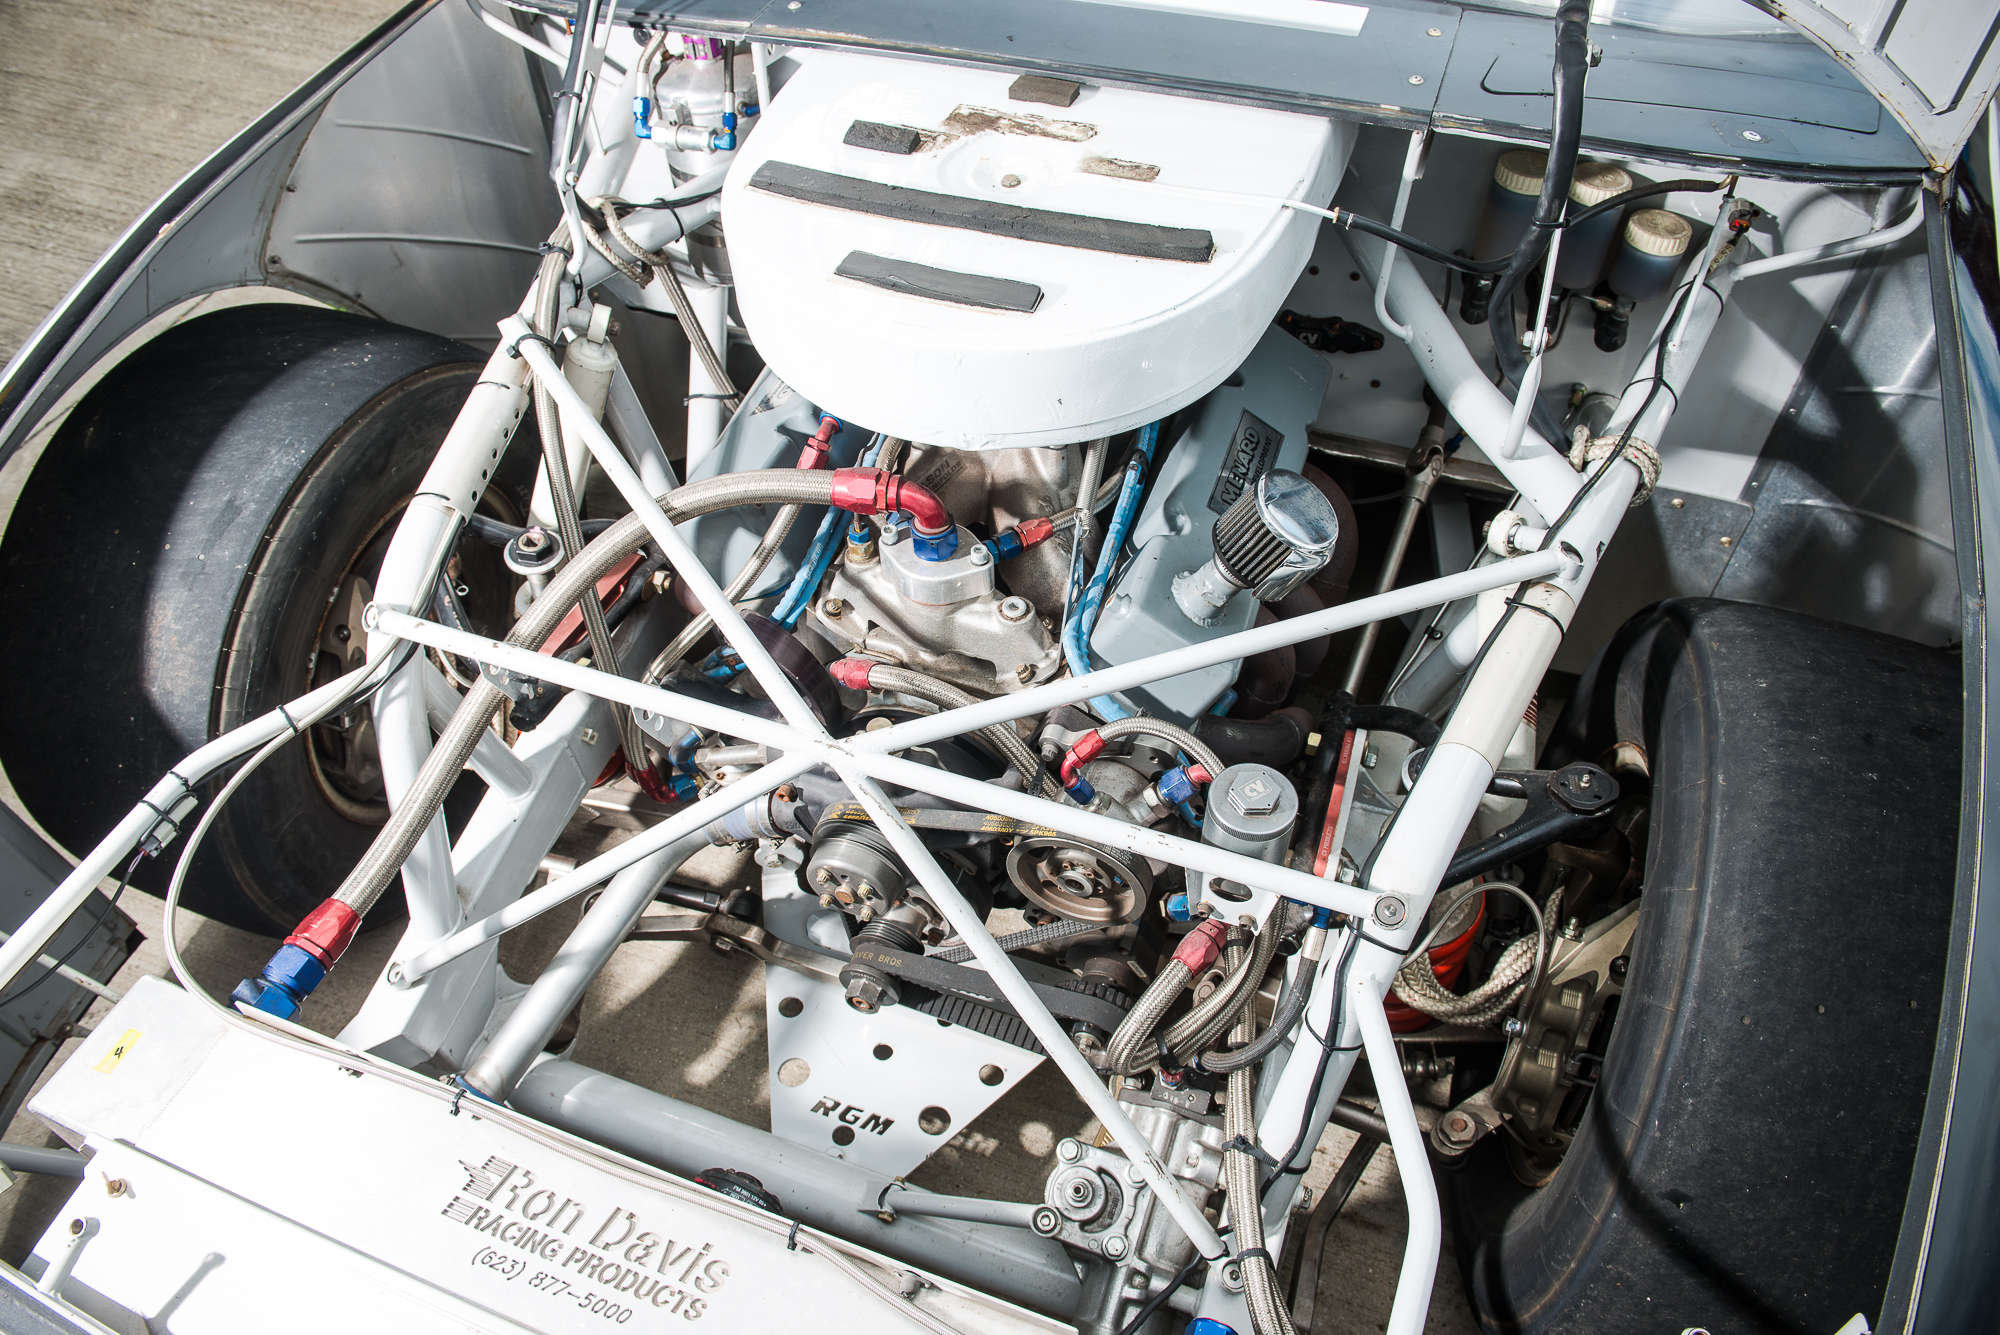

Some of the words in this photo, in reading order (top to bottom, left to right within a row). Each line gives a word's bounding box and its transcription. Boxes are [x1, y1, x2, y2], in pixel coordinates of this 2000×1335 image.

[1298, 332, 1319, 345] CV
[1220, 426, 1261, 505] MENARD
[1243, 779, 1265, 798] CV
[878, 953, 903, 968] BROS
[114, 1046, 124, 1060] 4
[810, 1095, 895, 1136] RGM
[484, 1164, 585, 1235] Ron
[589, 1206, 731, 1294] Davis
[463, 1205, 565, 1262] RACING
[561, 1246, 708, 1322] PRODUCTS
[471, 1245, 527, 1281] (623)
[528, 1270, 634, 1325] 877-5000
